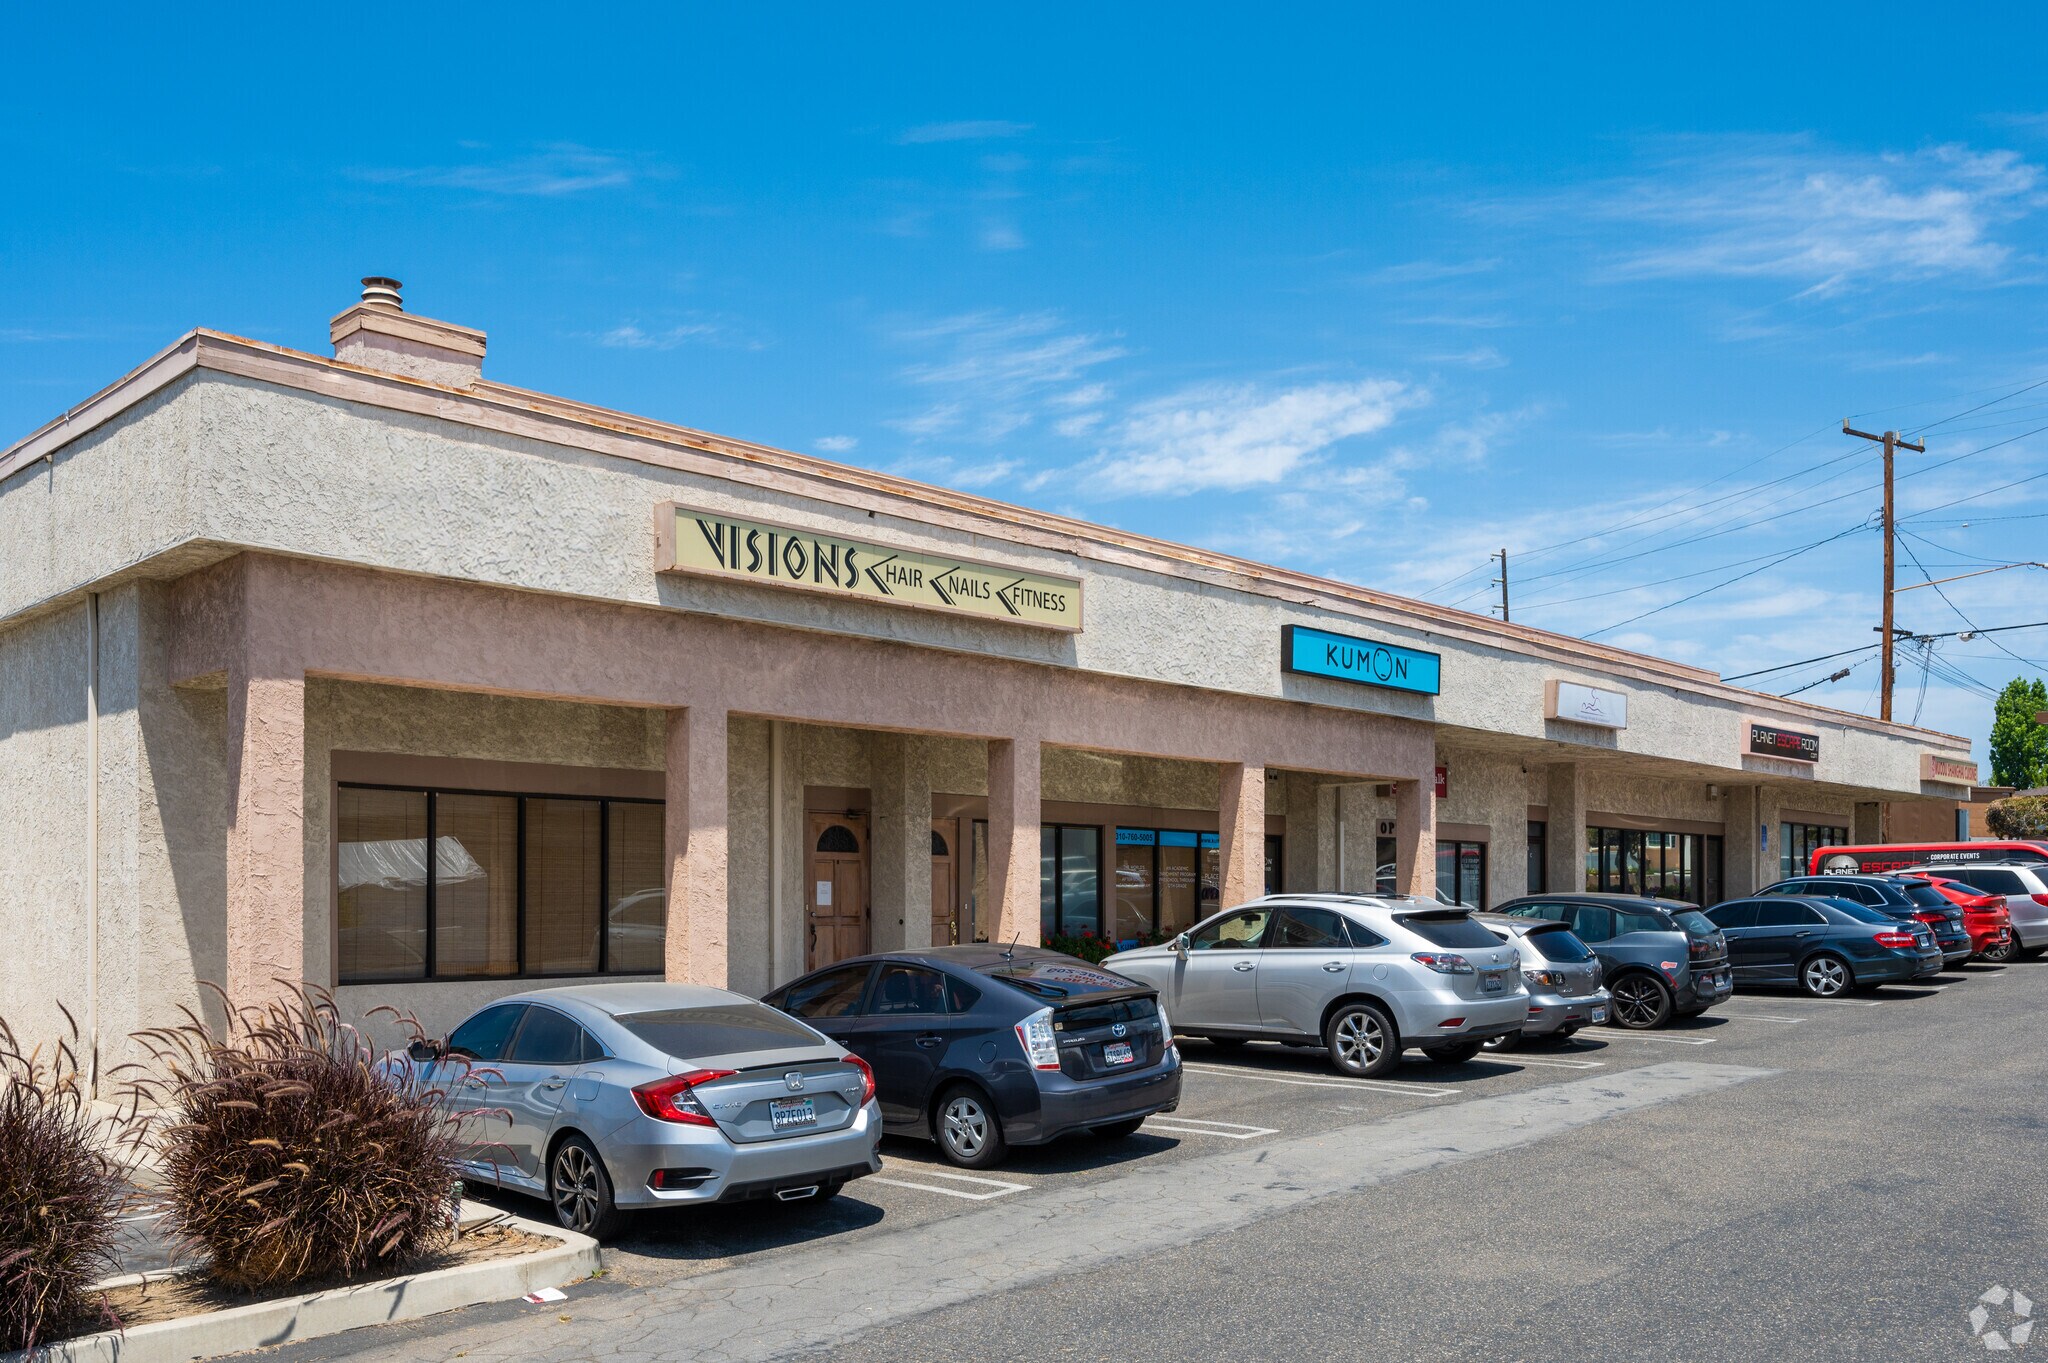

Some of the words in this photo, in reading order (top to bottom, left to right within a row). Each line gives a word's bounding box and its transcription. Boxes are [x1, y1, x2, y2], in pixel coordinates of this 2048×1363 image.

[695, 518, 859, 589] VISIONS
[885, 567, 923, 589] HAIR
[949, 575, 990, 600] NAILS
[1013, 586, 1066, 613] FITNESS
[1326, 643, 1408, 681] KUMON
[1752, 729, 1777, 745] PLANET
[1777, 733, 1801, 750] ESCAPE
[1801, 738, 1818, 751] ROOM
[1861, 861, 1921, 873] ESCA
[1930, 853, 1959, 861] CORPORATE
[1960, 852, 1980, 860] EVENTS
